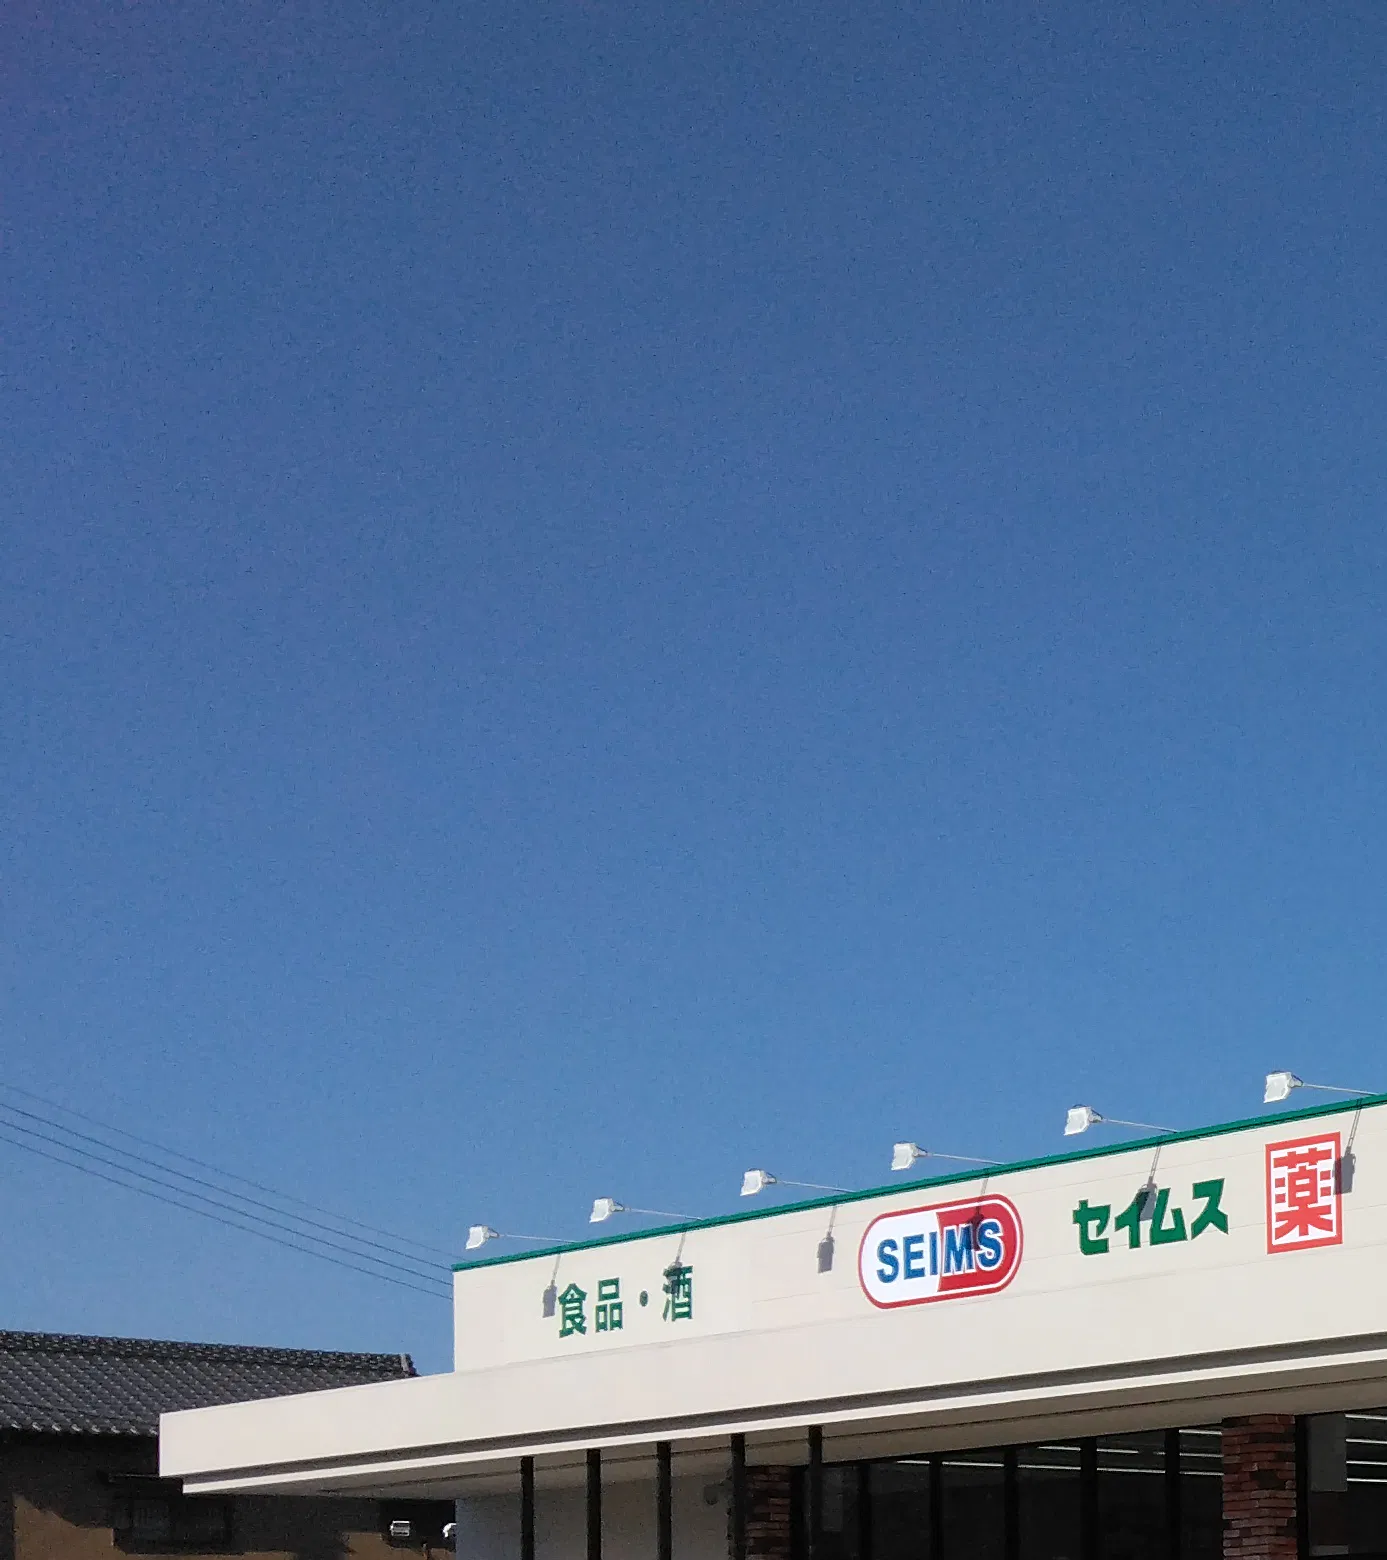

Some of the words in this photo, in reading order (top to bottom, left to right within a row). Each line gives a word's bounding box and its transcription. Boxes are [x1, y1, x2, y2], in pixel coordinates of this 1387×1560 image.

[1072, 1177, 1230, 1256] セイムス
[1273, 1145, 1336, 1244] 薬
[876, 1220, 1005, 1284] SEIMS
